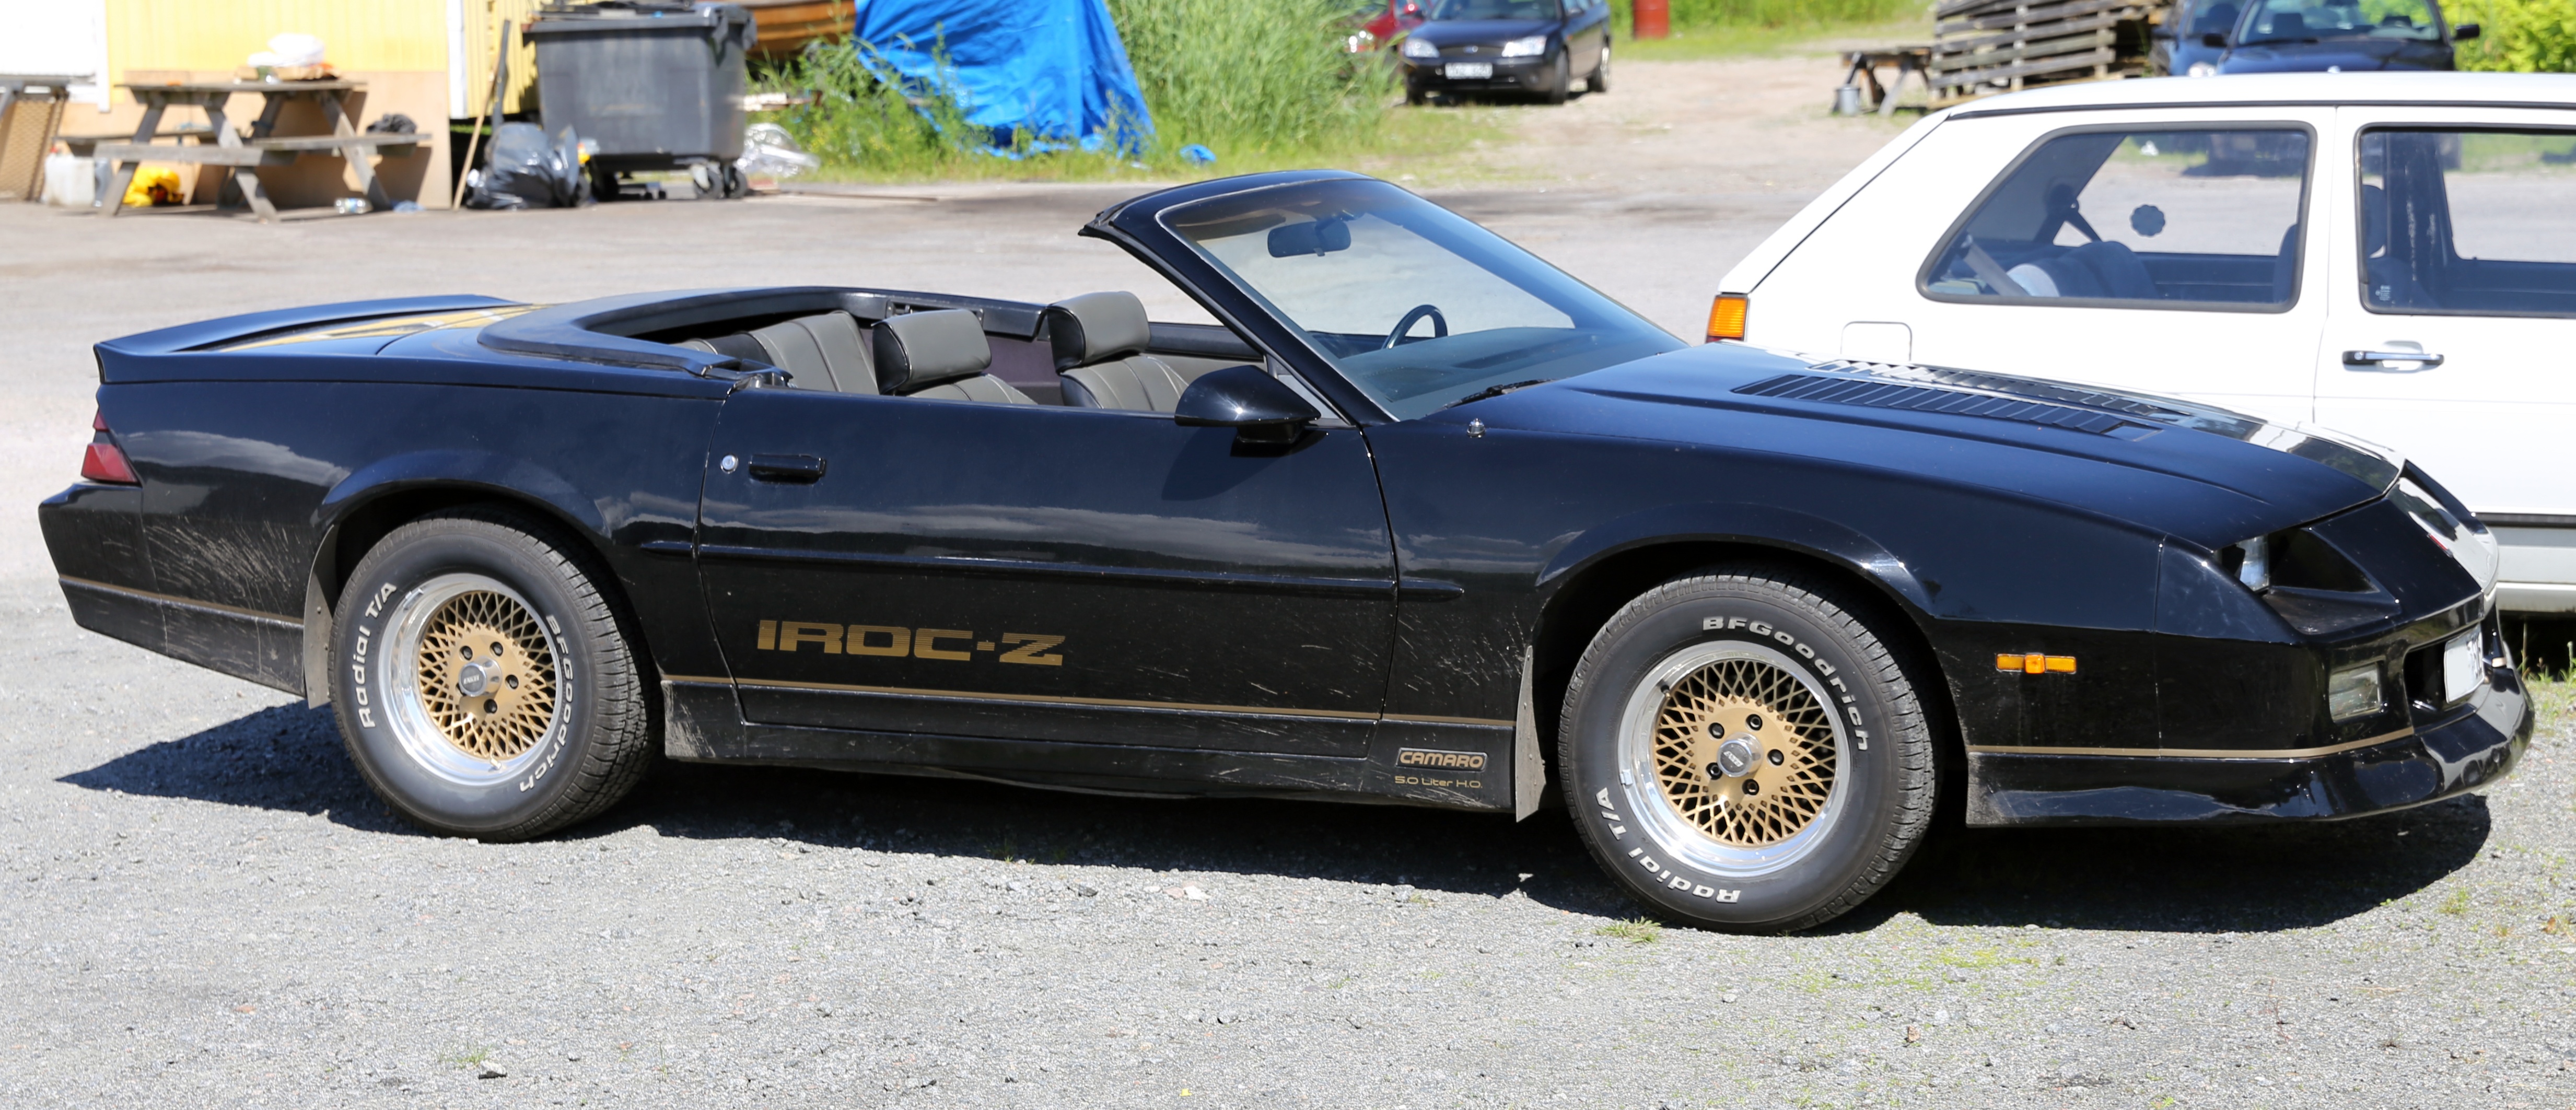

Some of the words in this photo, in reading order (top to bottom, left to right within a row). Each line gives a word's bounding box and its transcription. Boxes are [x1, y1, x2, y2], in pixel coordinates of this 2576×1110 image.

[352, 625, 376, 728] Radial
[365, 582, 397, 618] T/A
[757, 620, 1066, 666] IROC-Z
[519, 615, 574, 792] BFGoodrich
[1703, 616, 1869, 751] BFGoodrich
[1394, 776, 1419, 785] 5.0
[1421, 777, 1453, 787] Liter
[1456, 780, 1483, 788] H.O.
[1400, 752, 1484, 768] CAMARO
[1595, 787, 1627, 841] T/A
[1627, 847, 1741, 904] Radial
